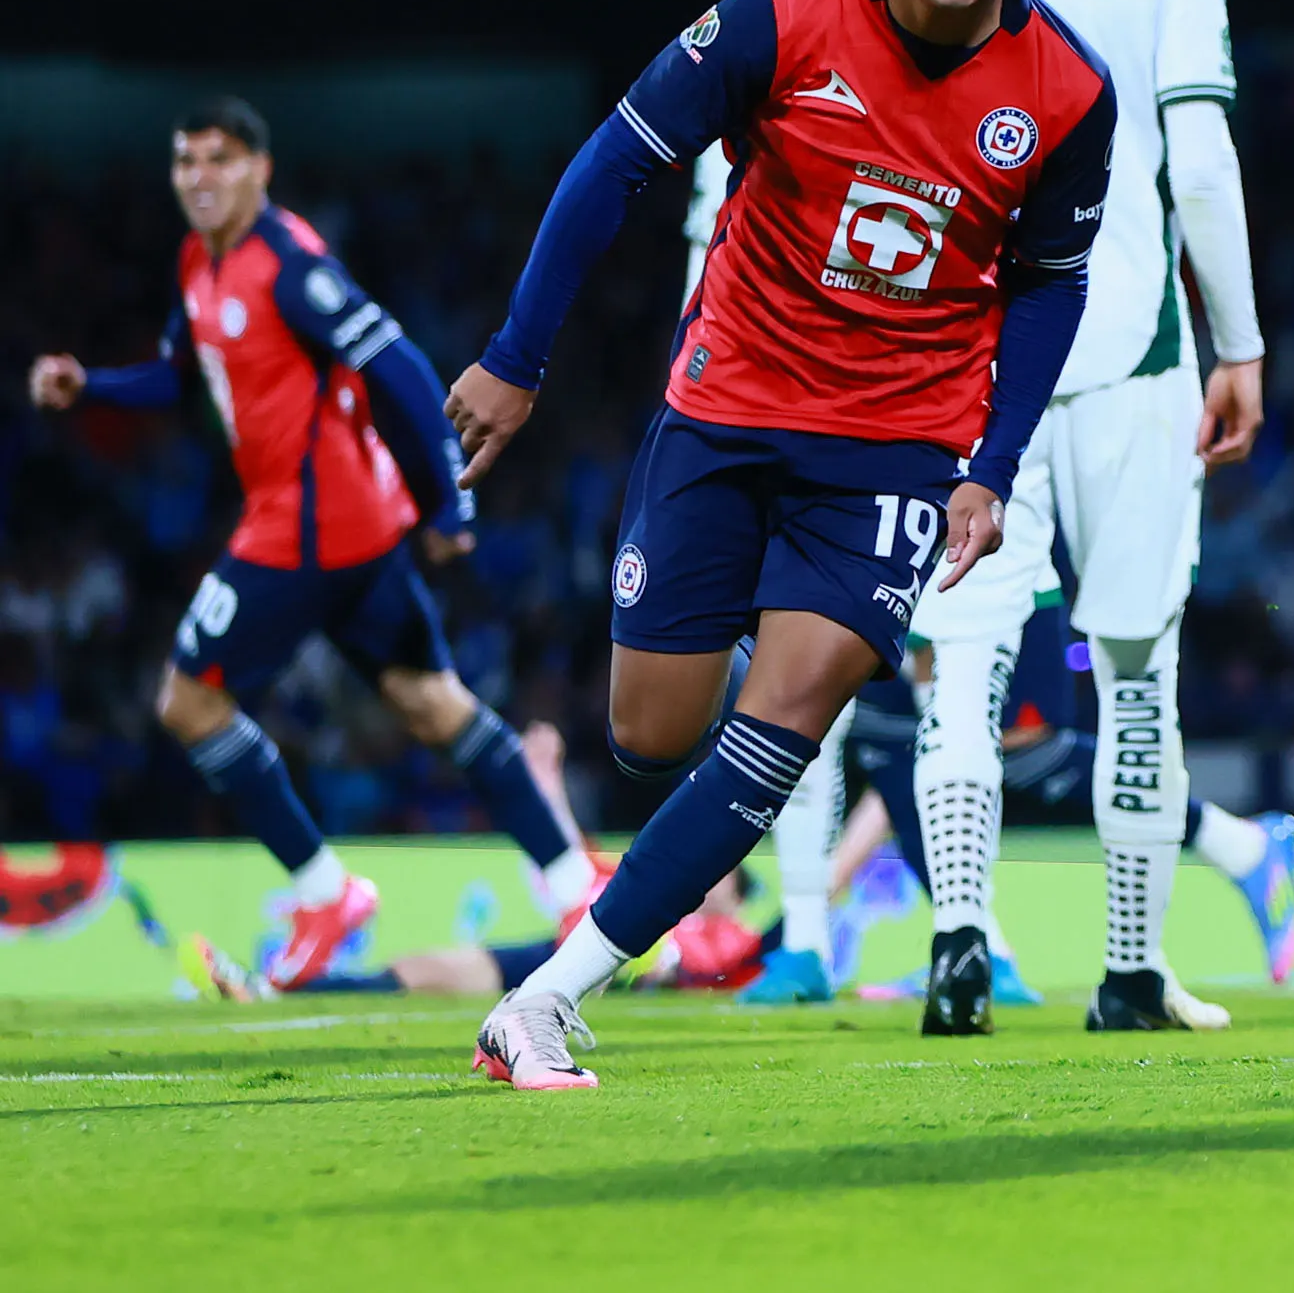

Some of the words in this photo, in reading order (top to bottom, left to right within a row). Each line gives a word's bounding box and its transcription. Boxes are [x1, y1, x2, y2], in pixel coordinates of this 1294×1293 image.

[854, 162, 962, 207] CEMENTO
[820, 268, 871, 290] CRUZ
[874, 279, 922, 302] AZUL
[874, 494, 938, 570] 19
